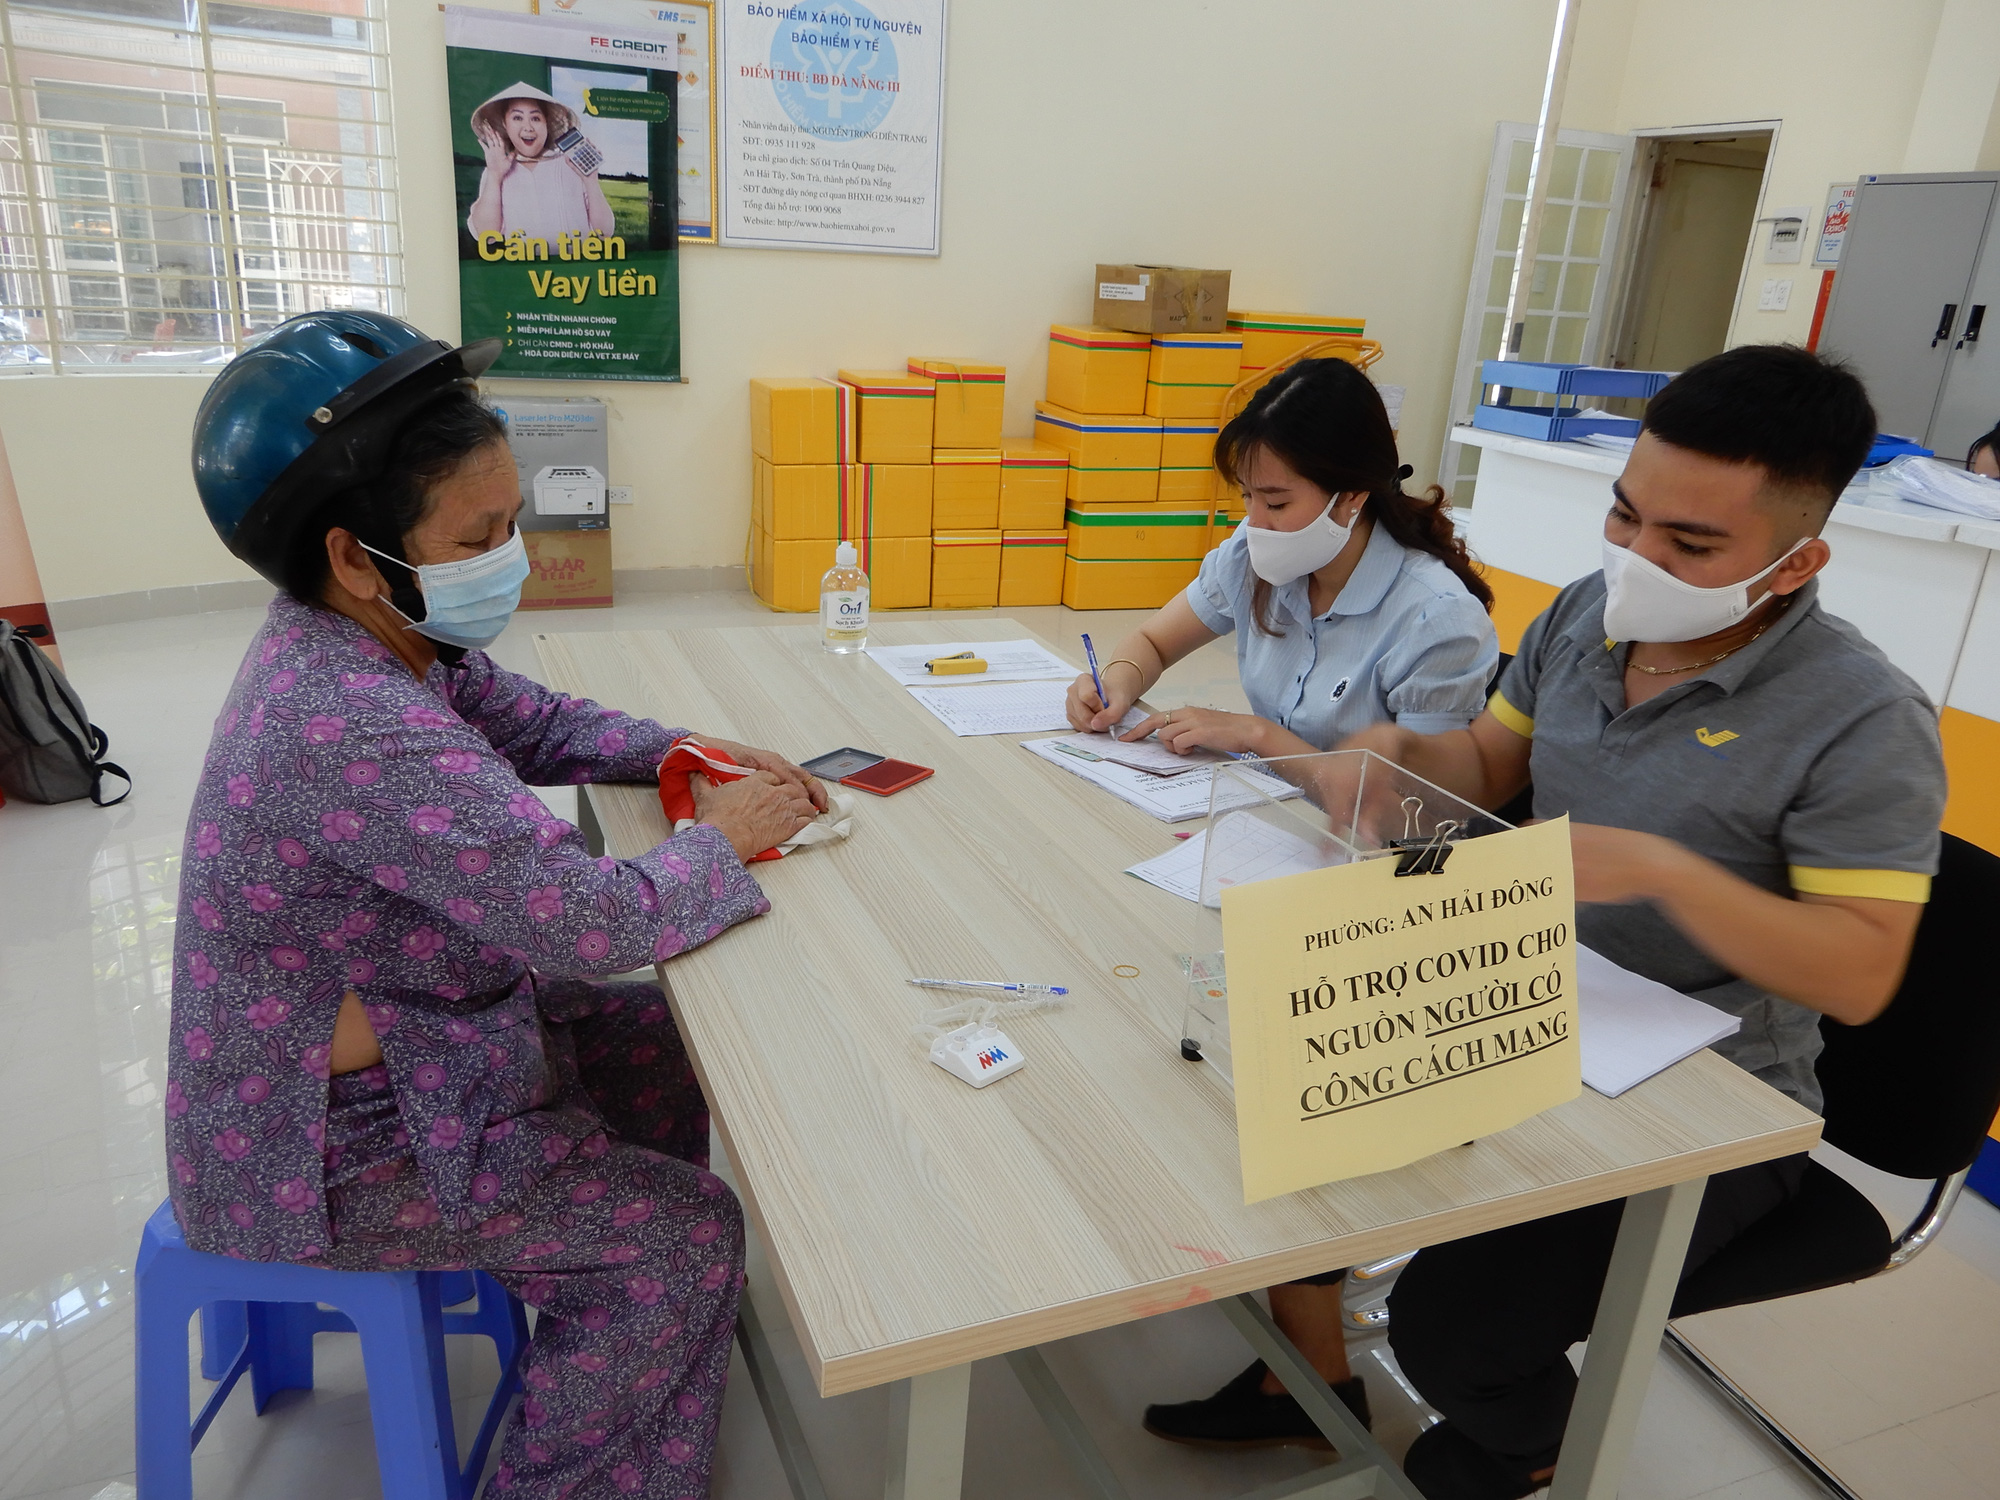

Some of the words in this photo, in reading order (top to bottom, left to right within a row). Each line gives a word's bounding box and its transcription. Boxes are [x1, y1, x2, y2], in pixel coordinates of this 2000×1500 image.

[658, 11, 680, 22] EMS
[748, 2, 774, 17] BẢO
[777, 5, 807, 21] HIỂM
[812, 11, 827, 24] XÃ
[831, 13, 851, 28] HỘI
[855, 17, 870, 30] TỰ
[874, 20, 922, 37] NGUYỆN
[591, 37, 610, 48] FE
[613, 39, 668, 54] CREDIT
[792, 30, 818, 45] BẢO
[821, 32, 850, 49] HIỂM
[854, 40, 862, 50] Y
[865, 38, 880, 52] TẾ
[741, 63, 775, 80] ĐIỂM
[778, 69, 810, 84] THU:
[813, 74, 829, 85] BĐ
[832, 73, 848, 87] ĐÀ
[851, 71, 885, 91] NẴNG
[888, 82, 901, 92] III
[742, 120, 761, 130] Nhân
[763, 122, 778, 131] viên
[778, 123, 789, 132] đại
[900, 134, 928, 144] TRANG
[743, 137, 763, 146] SĐT:
[765, 139, 784, 147] 0935
[787, 140, 799, 149] 111
[802, 142, 816, 150] 928
[743, 153, 757, 162] Địa
[759, 154, 770, 162] chỉ
[772, 155, 788, 165] giao
[790, 156, 808, 166] dịch:
[833, 159, 850, 169] Trần
[852, 161, 875, 173] Quang
[878, 163, 897, 173] Diệu,
[744, 169, 754, 177] An
[757, 170, 770, 178] Hải
[772, 171, 789, 181] Tây,
[791, 172, 805, 181] Sơn
[807, 174, 822, 183] Trà,
[824, 176, 844, 184] thành
[845, 176, 860, 187] phố
[861, 178, 871, 186] Đà
[873, 178, 892, 189] Nẵng
[743, 185, 760, 193] SĐT
[762, 187, 785, 197] đường
[786, 188, 798, 198] dây
[801, 189, 818, 199] nóng
[848, 193, 874, 202] BHXH:
[876, 195, 893, 204] 0236
[743, 201, 763, 211] Tổng
[765, 202, 776, 210] đài
[805, 205, 822, 213] 1900
[743, 216, 775, 226] Website:
[478, 229, 549, 262] Cần
[557, 229, 626, 261] tiền
[528, 270, 590, 304] Vay
[598, 268, 656, 297] liền
[542, 312, 561, 322] TIỀN
[561, 315, 590, 324] NHANH
[590, 316, 617, 325] CHÓNG
[539, 326, 553, 334] PHÍ
[554, 327, 571, 335] LÀM
[550, 341, 573, 349] CMND
[580, 342, 592, 350] HỘ
[623, 352, 640, 361] MÁY
[549, 414, 563, 422] Pro
[530, 558, 586, 574] POLAR
[840, 602, 862, 615] On1
[1304, 917, 1395, 952] PHƯỜNG:
[1401, 903, 1434, 930] AN
[1441, 889, 1485, 920] HẢI
[1491, 876, 1554, 910] ĐÔNG
[1289, 976, 1337, 1018] HỖ
[1344, 961, 1408, 1003] TRỢ
[1416, 941, 1509, 984] COVID
[1517, 923, 1567, 960] CHO
[1306, 1010, 1416, 1064] NGUỒN
[1424, 981, 1520, 1031] NGƯỜI
[1528, 963, 1563, 1002] CÓ
[1301, 1065, 1395, 1114] CÔNG
[1403, 1038, 1487, 1085] CÁCH
[1493, 1011, 1569, 1055] MẠNG
